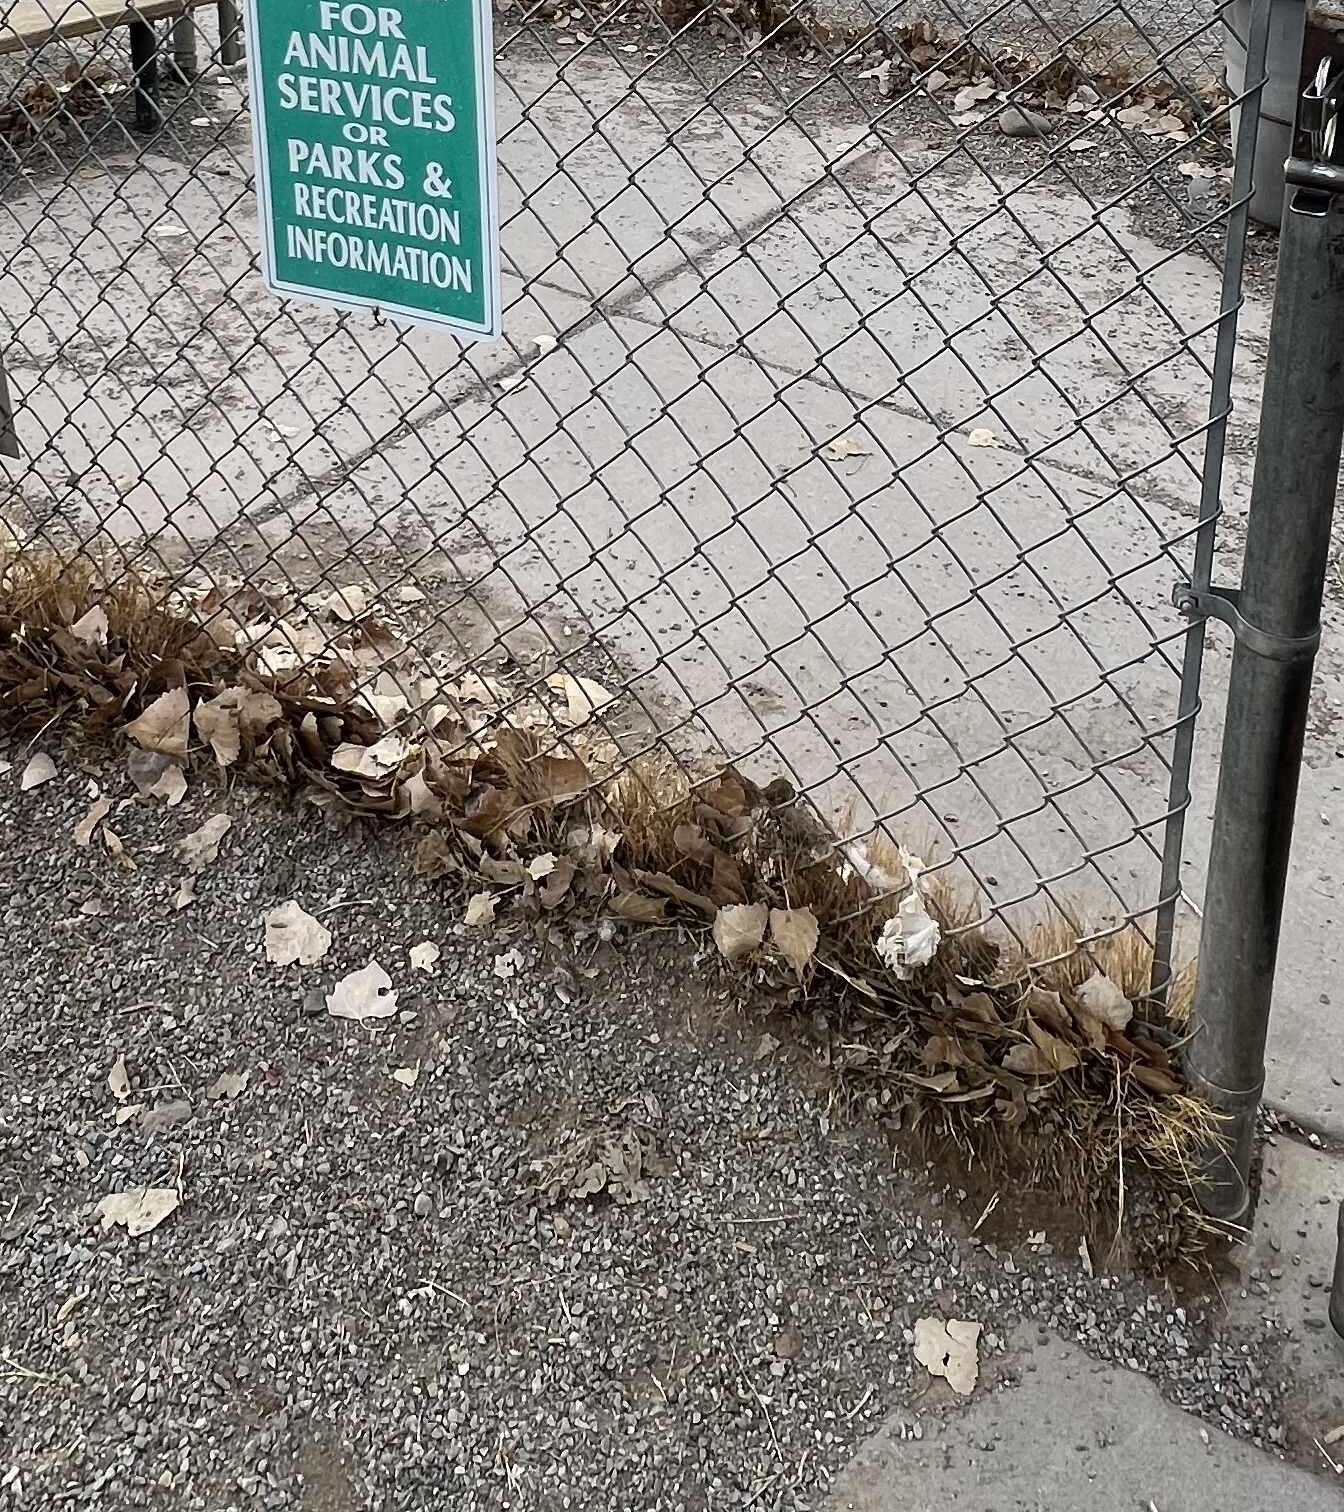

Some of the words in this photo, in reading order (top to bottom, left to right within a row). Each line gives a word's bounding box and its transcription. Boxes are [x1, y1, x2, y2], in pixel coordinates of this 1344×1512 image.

[320, 0, 406, 40] FOR
[283, 30, 437, 85] ANIMAL
[278, 72, 455, 132] SERVICES
[343, 122, 390, 148] OR
[287, 138, 405, 190] PARKS
[422, 161, 453, 199] &
[293, 182, 460, 246] RECREATION
[287, 224, 472, 294] INFORMATION
